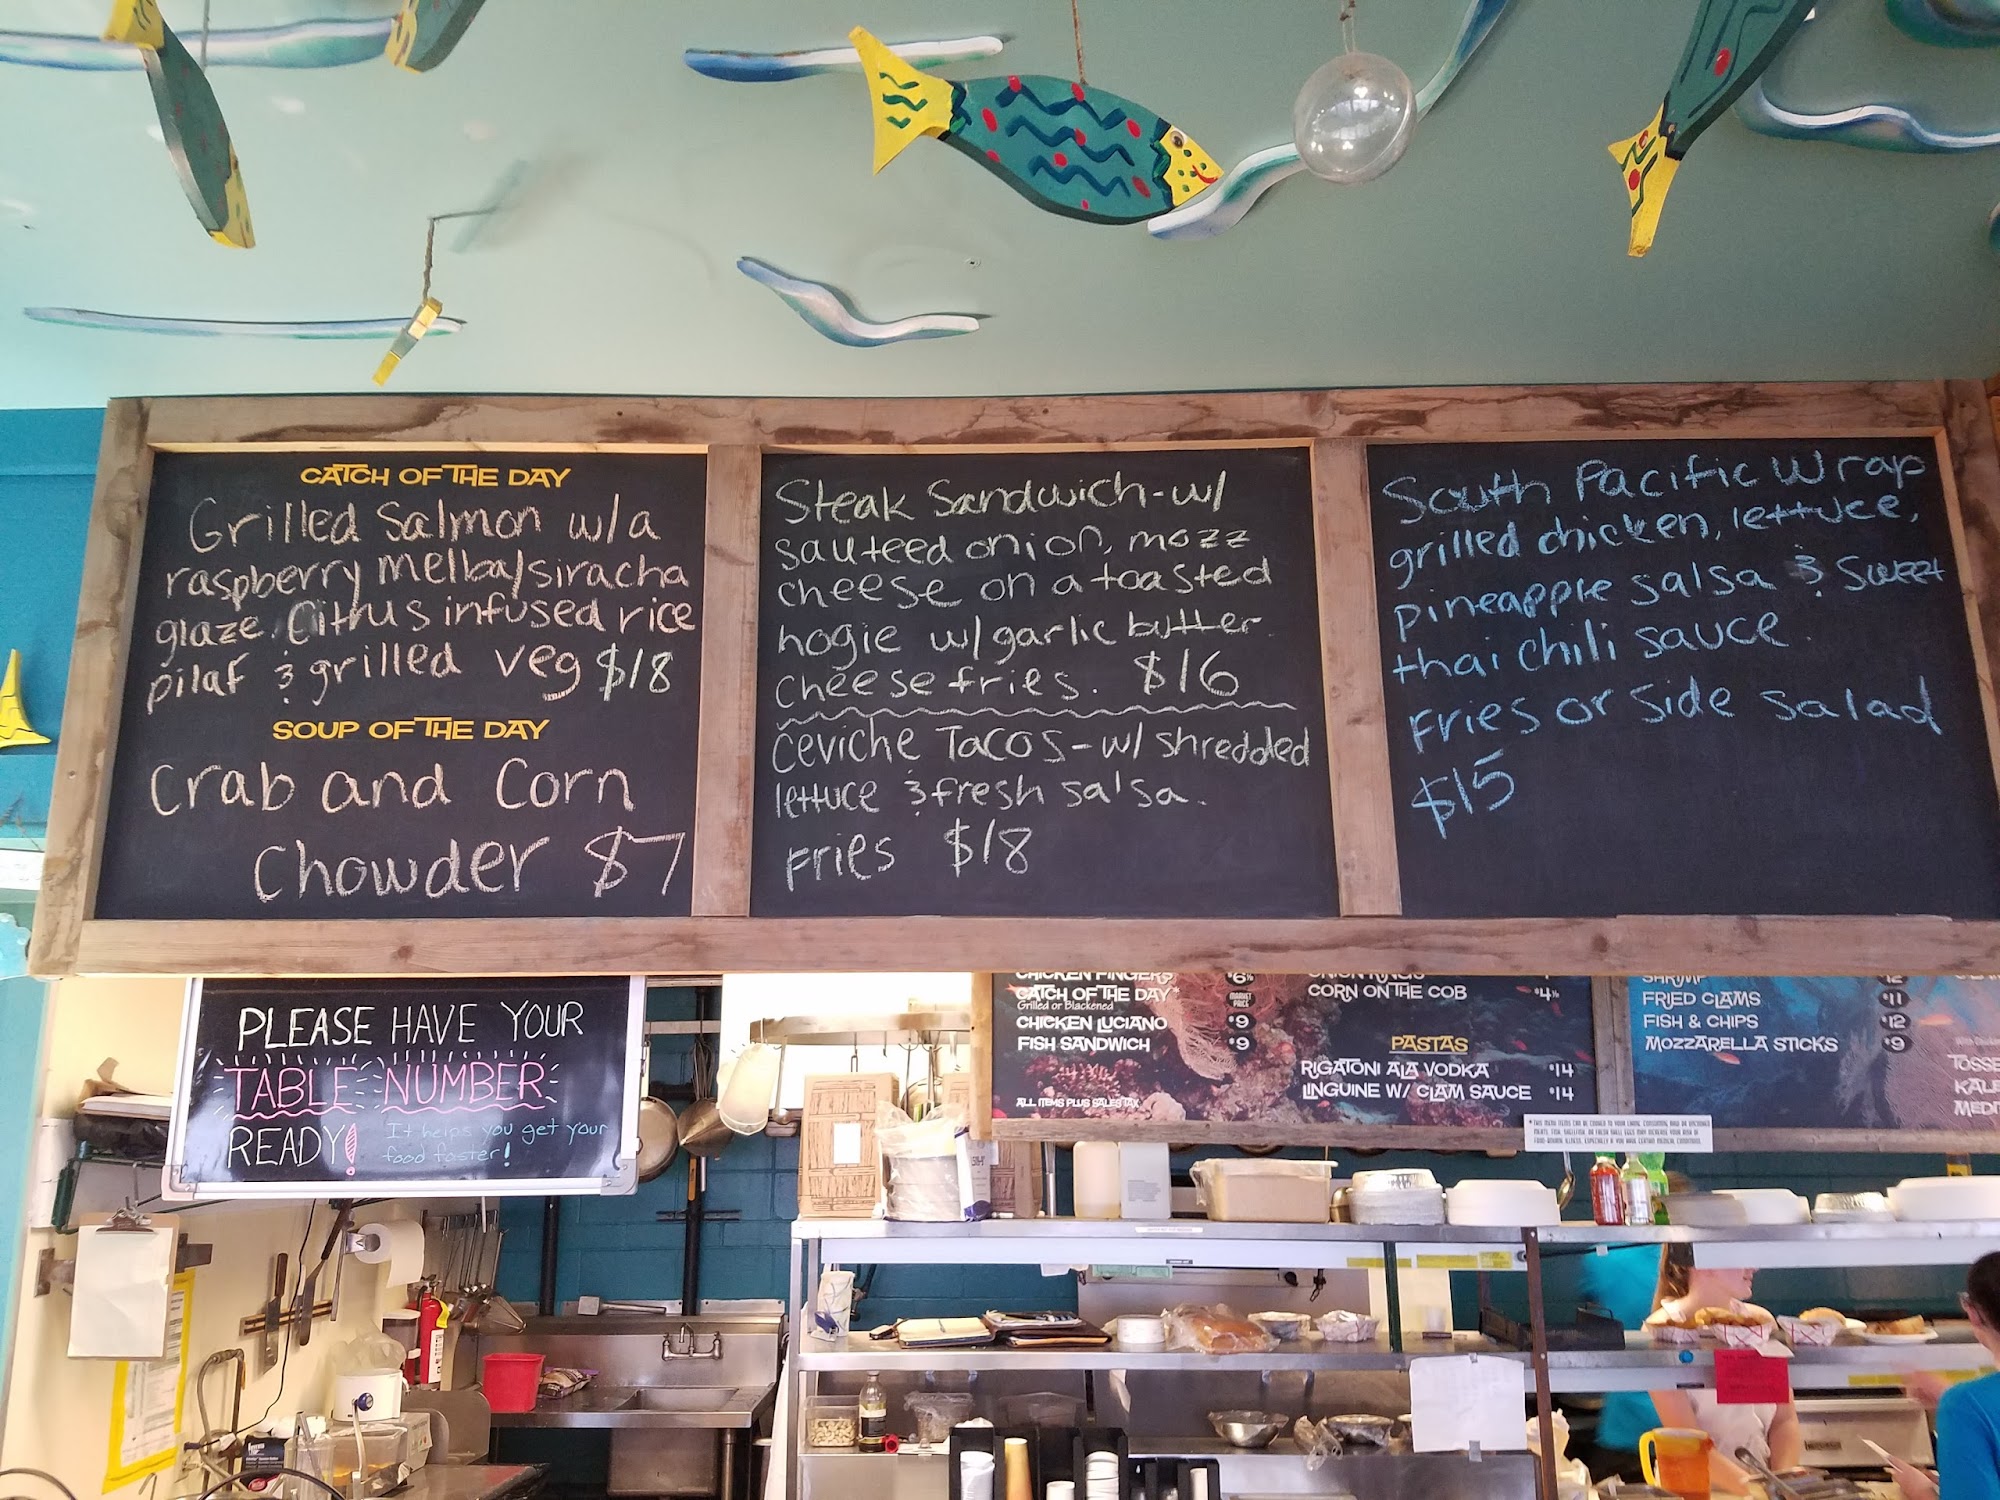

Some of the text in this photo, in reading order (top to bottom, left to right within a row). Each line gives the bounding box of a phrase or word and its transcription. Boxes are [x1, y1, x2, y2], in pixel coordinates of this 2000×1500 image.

[301, 463, 571, 488] CATCH OF THE DAY
[1381, 468, 1551, 525] South
[1575, 453, 1761, 503] Pacific
[775, 478, 914, 524] Steak
[189, 497, 361, 553] Grilled
[377, 499, 541, 544] Salmon
[775, 535, 954, 571] sauteed
[1129, 527, 1251, 552] mozz
[1389, 519, 1522, 590] grilled
[166, 559, 361, 622] raspberry
[777, 556, 1272, 610] cheese on a toasted
[1630, 561, 1778, 607] salsa
[444, 591, 607, 631] infused
[618, 596, 696, 634] rice
[777, 622, 902, 671] hogie
[992, 612, 1118, 665] garlic
[1392, 648, 1500, 685] thai
[1518, 617, 1616, 672] chili
[146, 652, 250, 715] pilaf
[308, 641, 462, 706] grilled
[494, 643, 582, 702] veg
[596, 642, 673, 702] $18
[775, 669, 936, 709] cheese
[1133, 648, 1240, 697] $16
[272, 716, 550, 741] SOUP OF THE DAY
[1555, 688, 1614, 725] or
[1158, 724, 1311, 768] shredded
[151, 756, 636, 816] Crab and Corn
[774, 780, 881, 819] lettuce
[930, 773, 1045, 811] fresh
[1411, 749, 1516, 840] $15
[254, 825, 686, 902] Chowder $7
[943, 817, 1033, 878] $18
[1015, 983, 1068, 1002] CATCH
[1072, 986, 1098, 1002] OF
[1096, 984, 1131, 1003] THE
[1017, 999, 1114, 1011] Grilled or Blackened
[1308, 983, 1358, 1002] CORN
[1362, 984, 1390, 999] ON
[1387, 981, 1424, 1000] THE
[1427, 984, 1468, 1000] COB
[1642, 991, 1697, 1010] FRIED
[1701, 990, 1761, 1010] CLAMS
[237, 1000, 584, 1052] PLEASE HAVE YOUR
[1016, 1015, 1093, 1031] CHICKEN
[1097, 1015, 1168, 1033] LUCIANO
[1017, 1035, 1056, 1052] FISH
[1060, 1035, 1151, 1052] SANDWICH
[1391, 1034, 1469, 1052] PASTAS
[1643, 1013, 1683, 1030] FISH
[1688, 1013, 1702, 1029] &
[1706, 1013, 1759, 1030] CHIPS
[1645, 1035, 1770, 1053] MOZZARELLA
[1772, 1035, 1839, 1053] STICKS
[224, 1062, 546, 1111] TABLE NUMBER
[1301, 1057, 1381, 1079] RIGATONI
[1423, 1060, 1490, 1079] VODKA
[1016, 1096, 1140, 1108] ALL ITEMS PLUS SALES TAX
[1302, 1081, 1381, 1100] LINGUINE
[1385, 1082, 1410, 1099] W/
[1416, 1083, 1464, 1102] CLAM
[1469, 1084, 1532, 1101] SAUCE
[227, 1121, 358, 1177] READY!
[387, 1117, 609, 1146] It helps you get your
[382, 1143, 426, 1165] food
